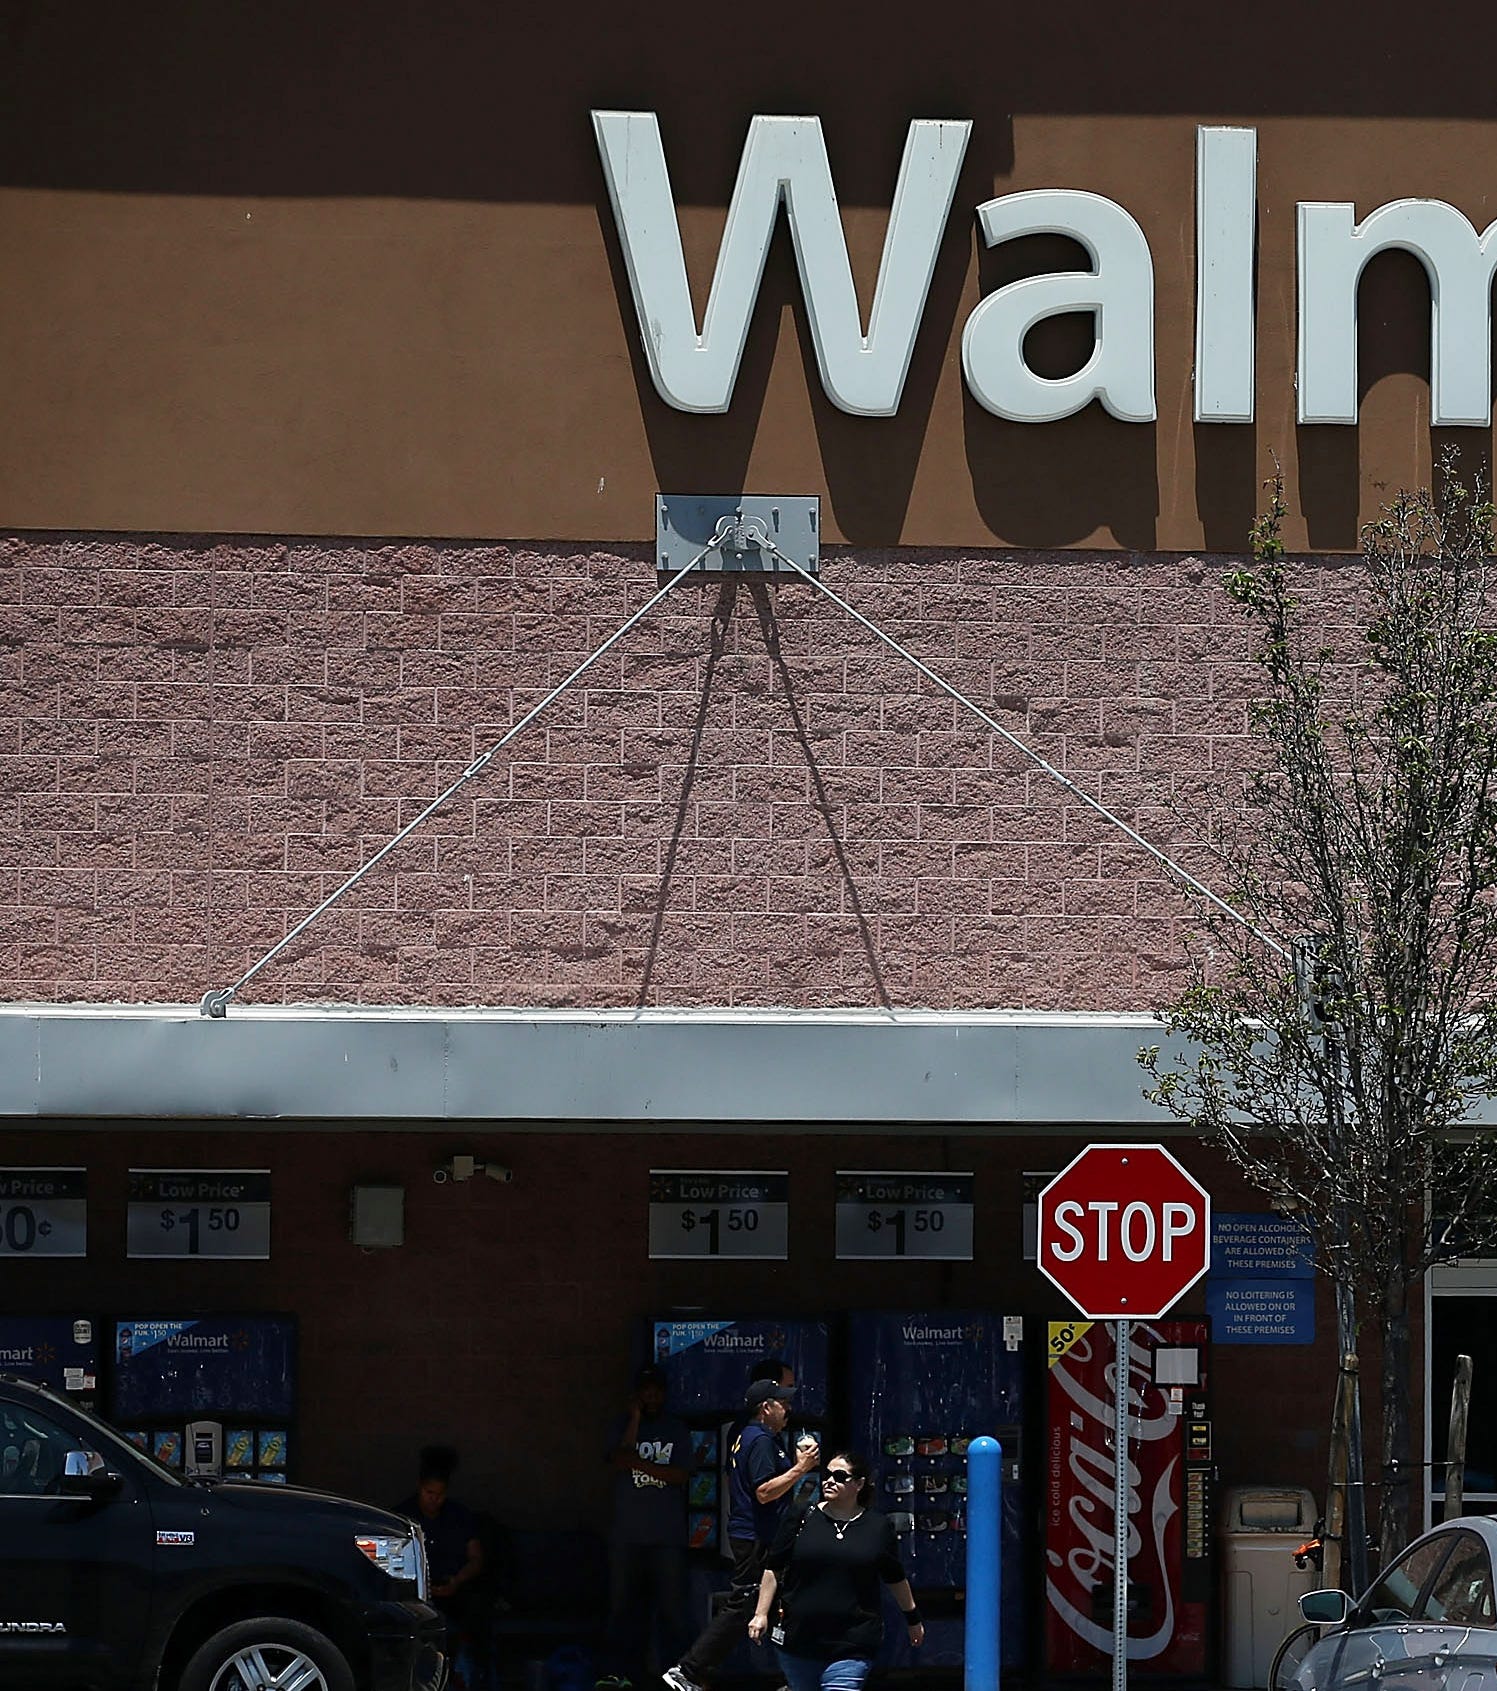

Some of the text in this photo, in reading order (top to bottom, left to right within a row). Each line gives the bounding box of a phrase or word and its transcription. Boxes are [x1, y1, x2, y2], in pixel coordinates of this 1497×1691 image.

[11, 1180, 54, 1195] Price
[160, 1182, 241, 1198] Low Price
[680, 1184, 759, 1199] Low Price
[866, 1185, 945, 1199] Low Price
[0, 1205, 52, 1251] 0¢
[1051, 1200, 1196, 1262] STOP
[1218, 1224, 1232, 1232] NO
[1233, 1224, 1257, 1232] OPEN
[1213, 1235, 1311, 1244] BEVERAGE CONTAINERS
[1224, 1247, 1298, 1255] ARE ALLOWED ON
[1227, 1260, 1296, 1269] THESE PREMISES
[1225, 1291, 1295, 1300] NO LOITERING IS
[1225, 1303, 1296, 1311] ALLOWED ON OR
[1233, 1314, 1287, 1322] IN FRONT OF
[902, 1326, 964, 1340] Walmart
[1225, 1326, 1296, 1334] THESE PREMISES
[167, 1334, 229, 1348] Walmart
[704, 1334, 764, 1347] Walmart
[1050, 1426, 1061, 1478] delicious
[1050, 1481, 1061, 1506] cold
[0, 1622, 67, 1632] UNDRA
